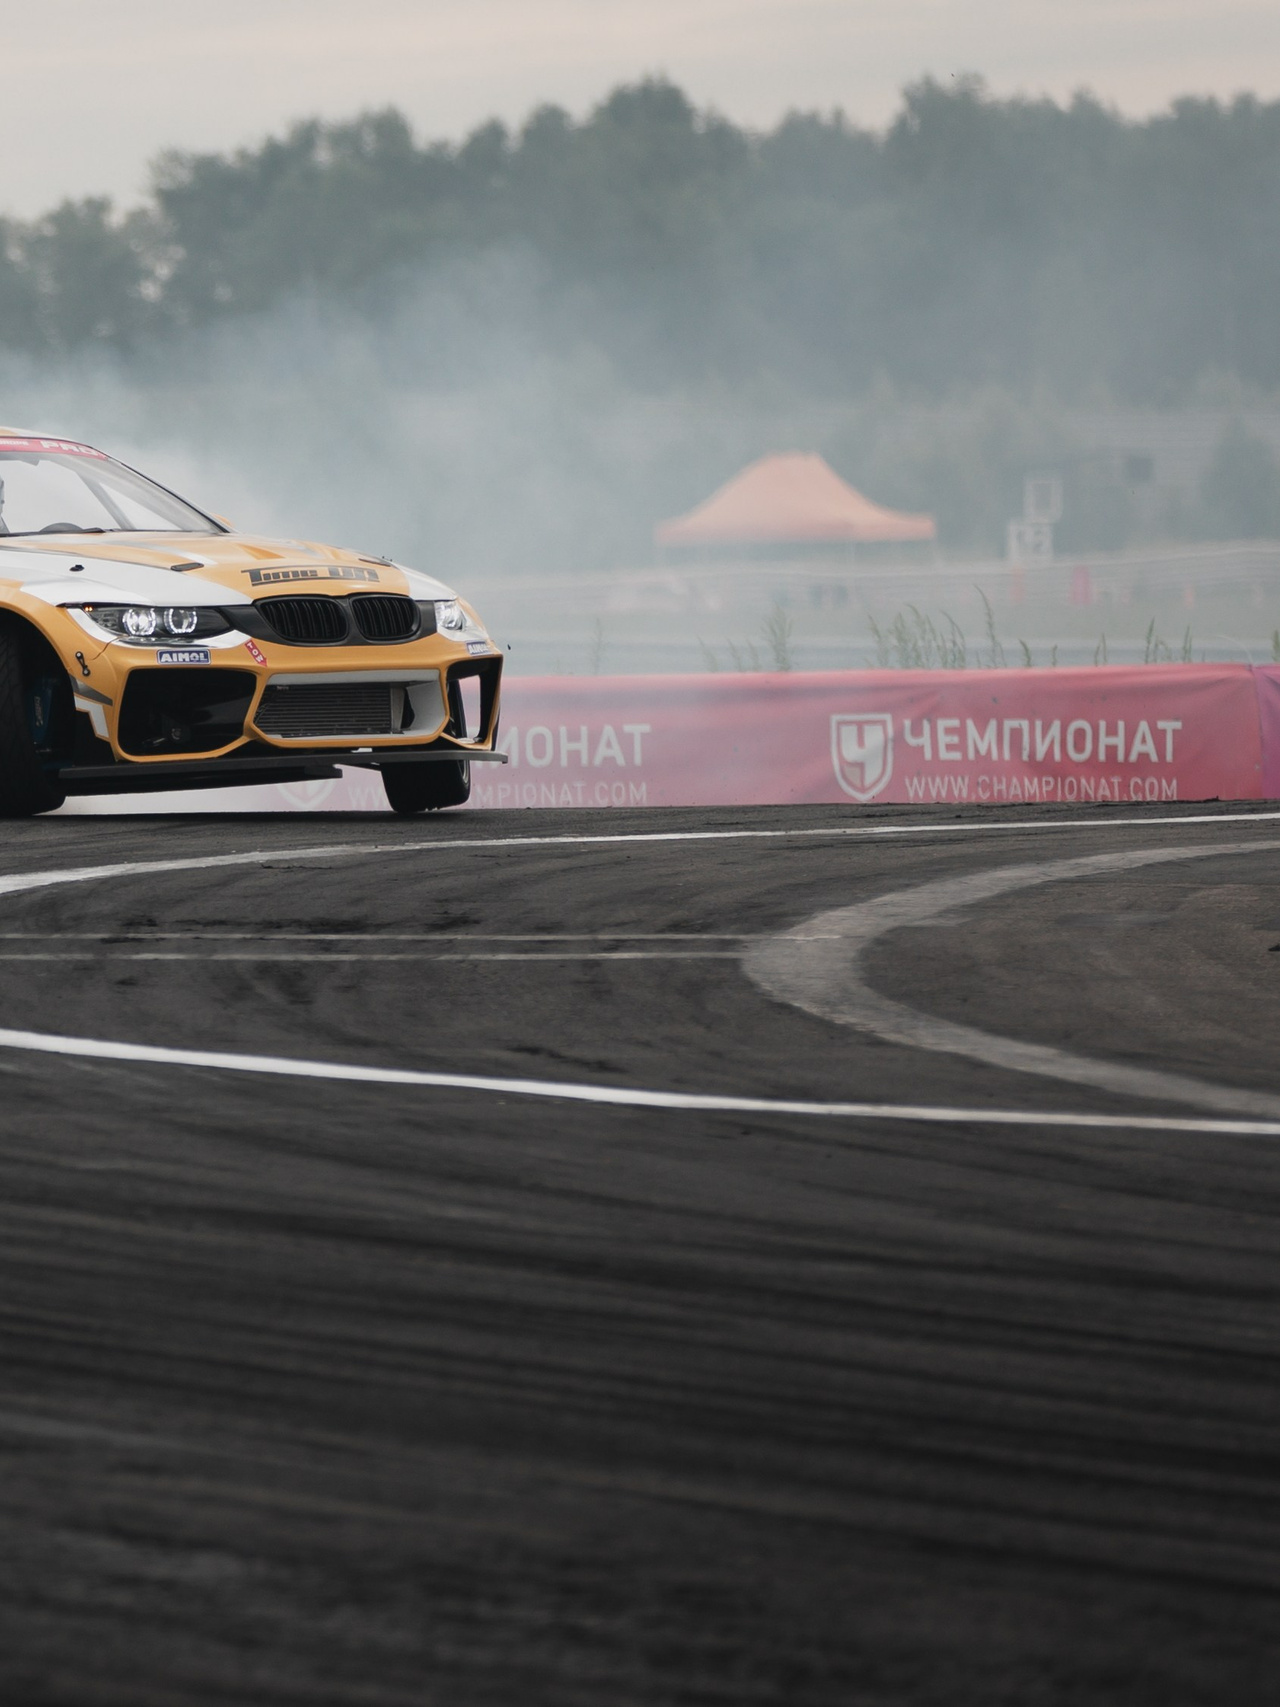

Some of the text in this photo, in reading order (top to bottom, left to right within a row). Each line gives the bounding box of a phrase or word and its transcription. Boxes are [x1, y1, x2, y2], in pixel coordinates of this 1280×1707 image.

[161, 652, 208, 662] AIMOL
[246, 641, 264, 663] TOW
[489, 723, 651, 769] ИОНАТ
[903, 718, 1182, 764] ЧЕМПИОНАТ
[904, 775, 1178, 801] WWW.CHAMPIONAT.COM
